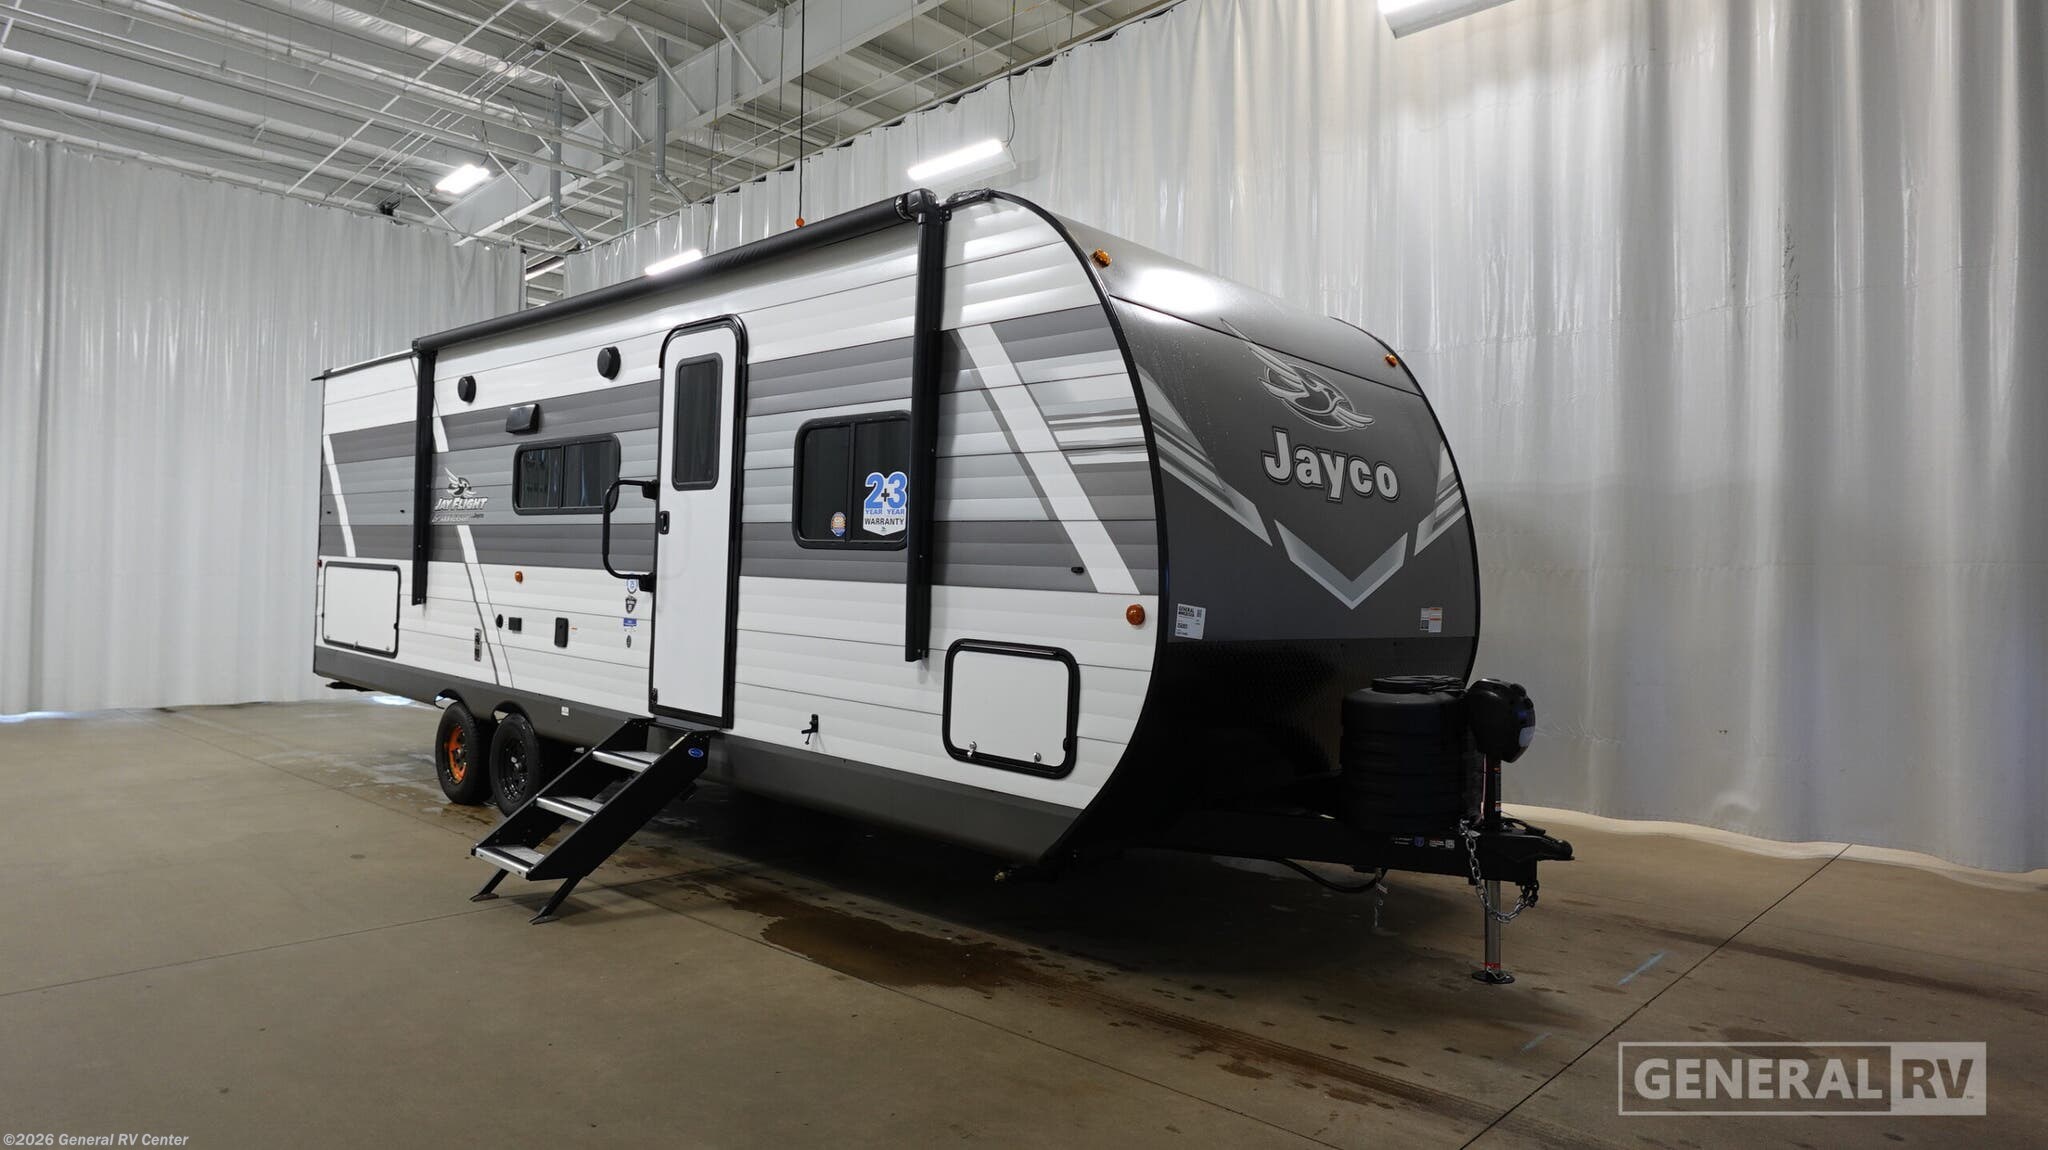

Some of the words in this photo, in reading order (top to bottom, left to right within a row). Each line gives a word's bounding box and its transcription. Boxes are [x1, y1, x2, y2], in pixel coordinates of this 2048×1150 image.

[1262, 427, 1399, 502] Jayco
[434, 498, 453, 510] JAY
[452, 497, 488, 510] FLIGHT
[864, 517, 905, 526] WARRANTY
